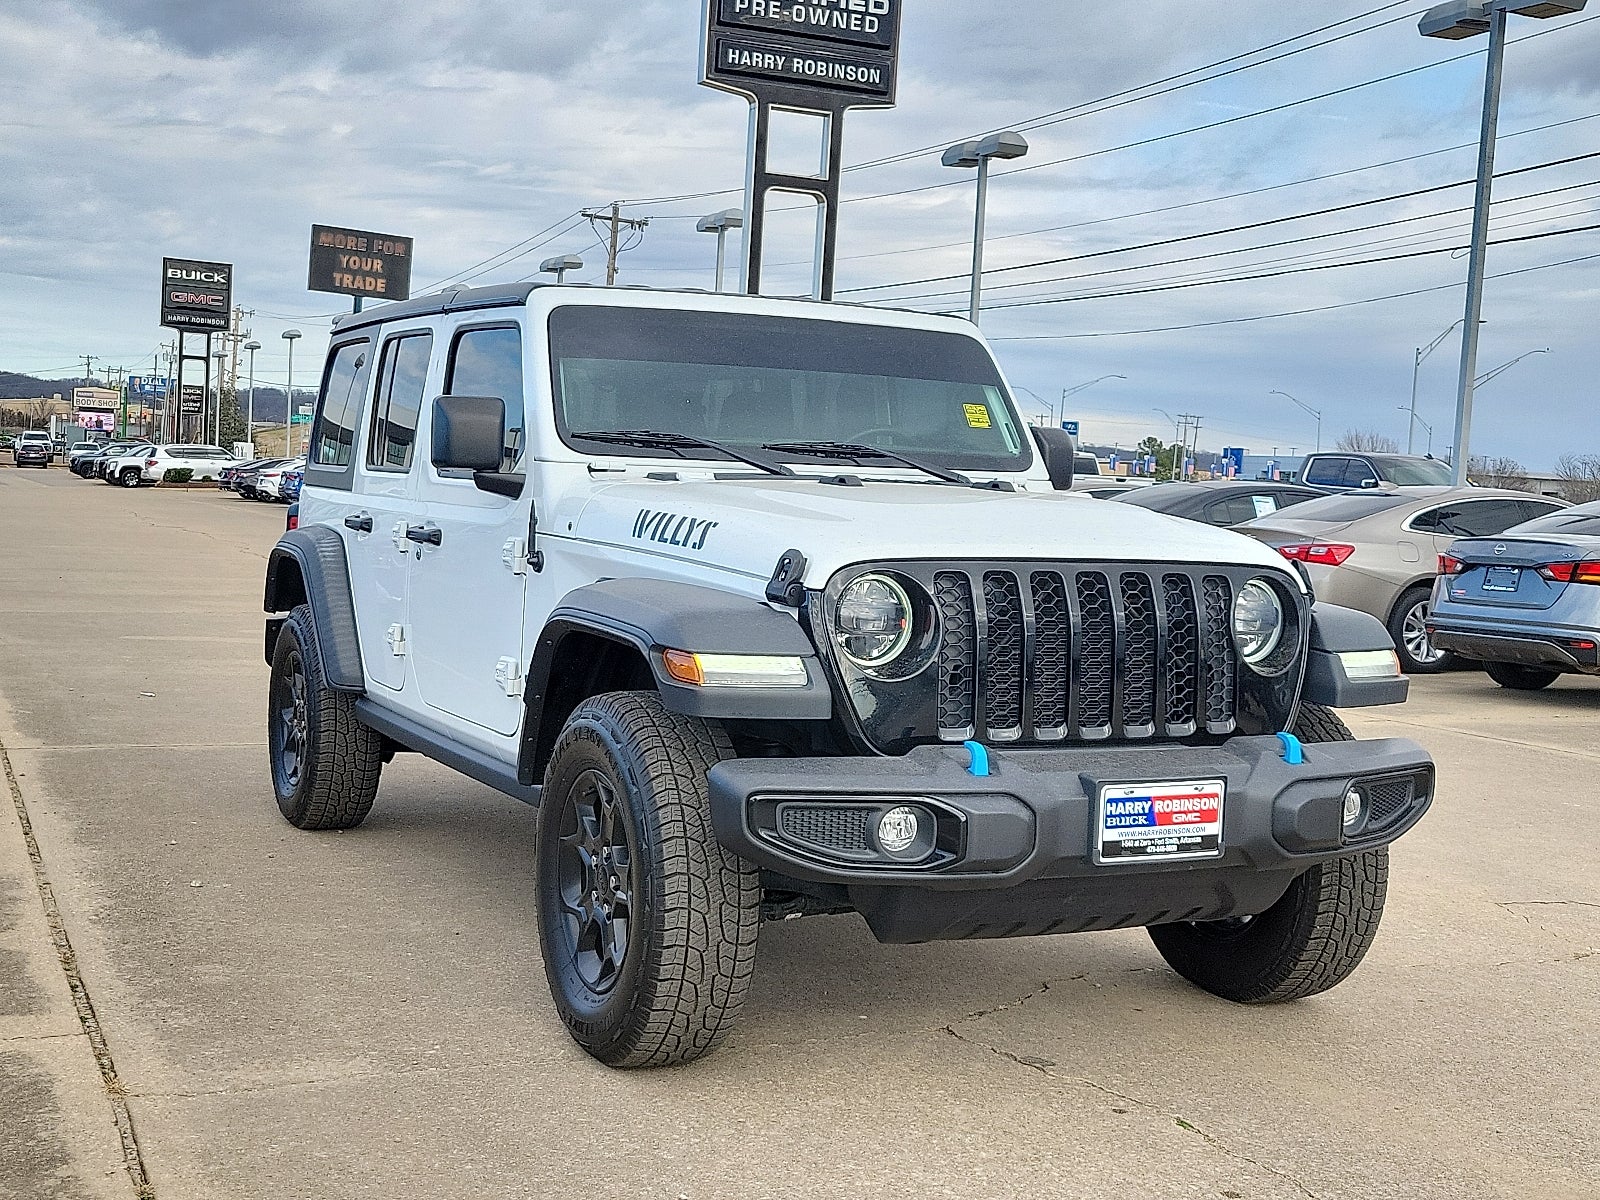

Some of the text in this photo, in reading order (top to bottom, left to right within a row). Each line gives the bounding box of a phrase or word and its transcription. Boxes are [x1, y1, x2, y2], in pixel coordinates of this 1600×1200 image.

[735, 0, 879, 33] PRE-OWNED
[728, 48, 881, 84] HARRY ROBINSON
[319, 232, 406, 257] MORE FOR
[339, 254, 384, 273] YOUR
[167, 268, 227, 283] BUICK
[333, 271, 387, 293] TRADE
[170, 291, 224, 306] GMC
[167, 314, 225, 325] HARRY ROBINSON
[75, 398, 118, 407] BODY SHOP
[632, 508, 720, 551] WILLYS
[1106, 797, 1218, 816] HARRY ROBINSON
[1106, 813, 1201, 827] BUICK GMC
[1118, 826, 1206, 838] WWW.HARRYROBINSON.COM
